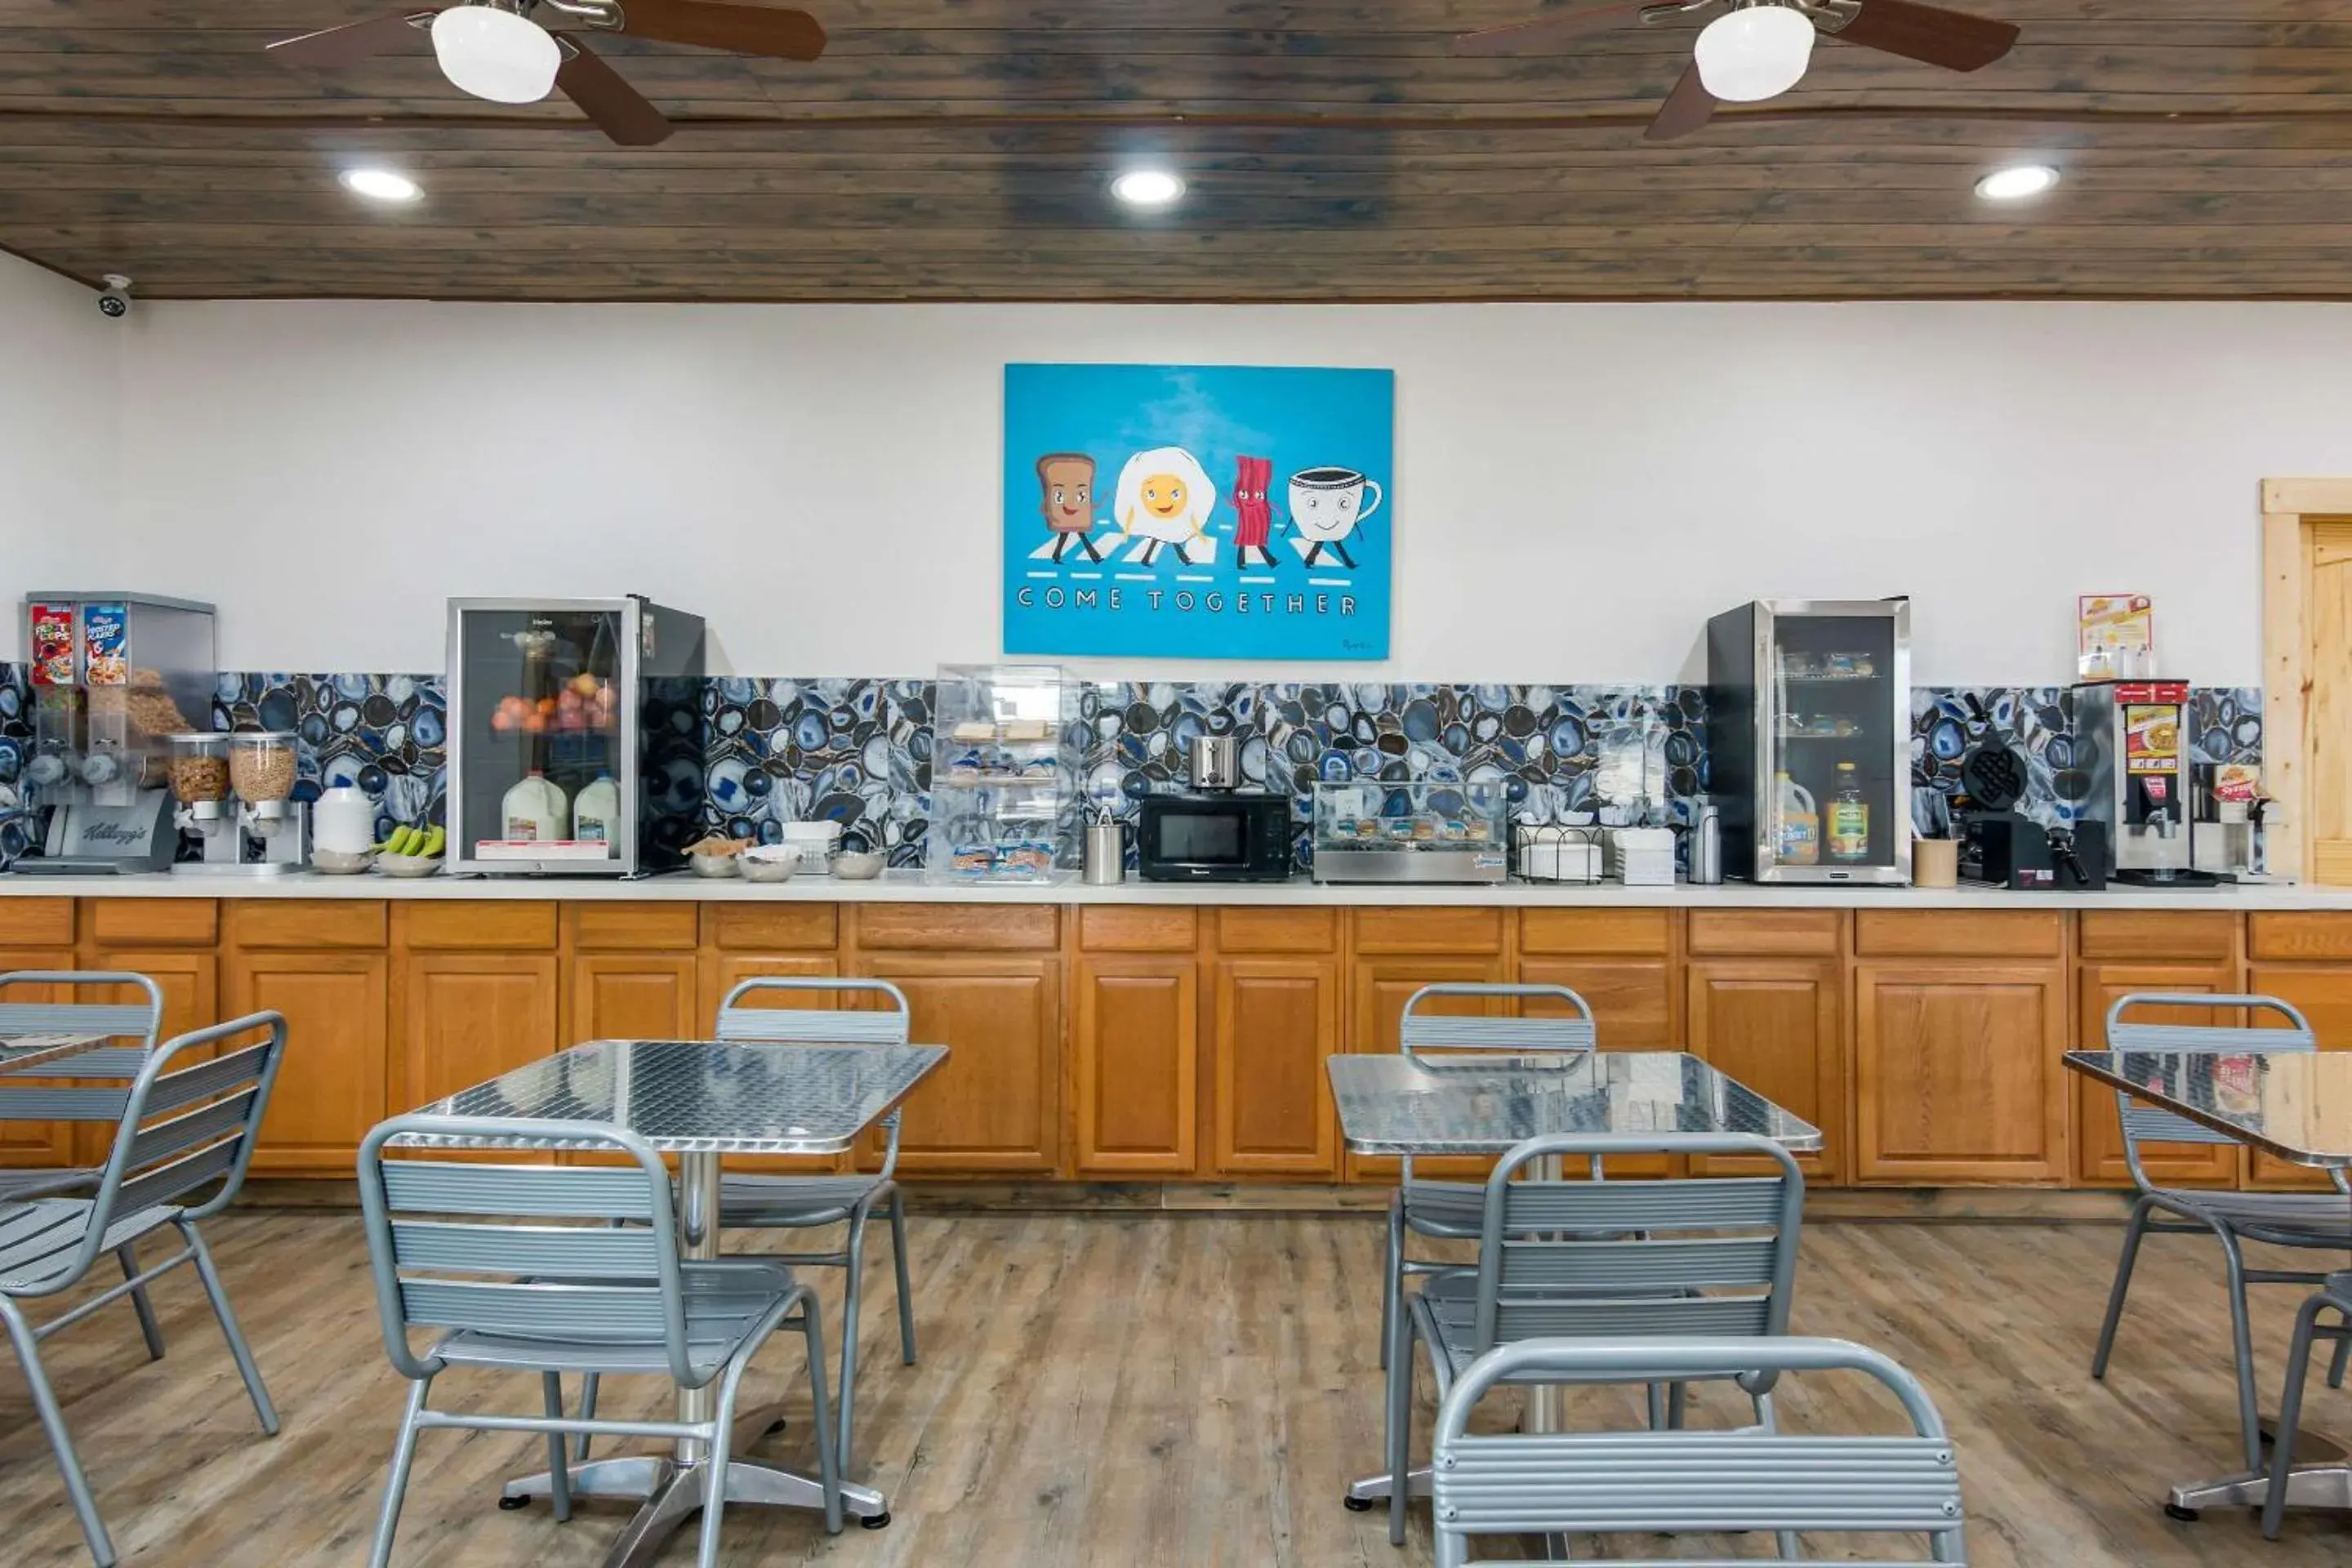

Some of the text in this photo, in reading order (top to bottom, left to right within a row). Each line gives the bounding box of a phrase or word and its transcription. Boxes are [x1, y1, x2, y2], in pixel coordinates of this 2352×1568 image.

[1018, 586, 1356, 616] COME TOGETHER
[82, 822, 147, 845] Kellogg's
